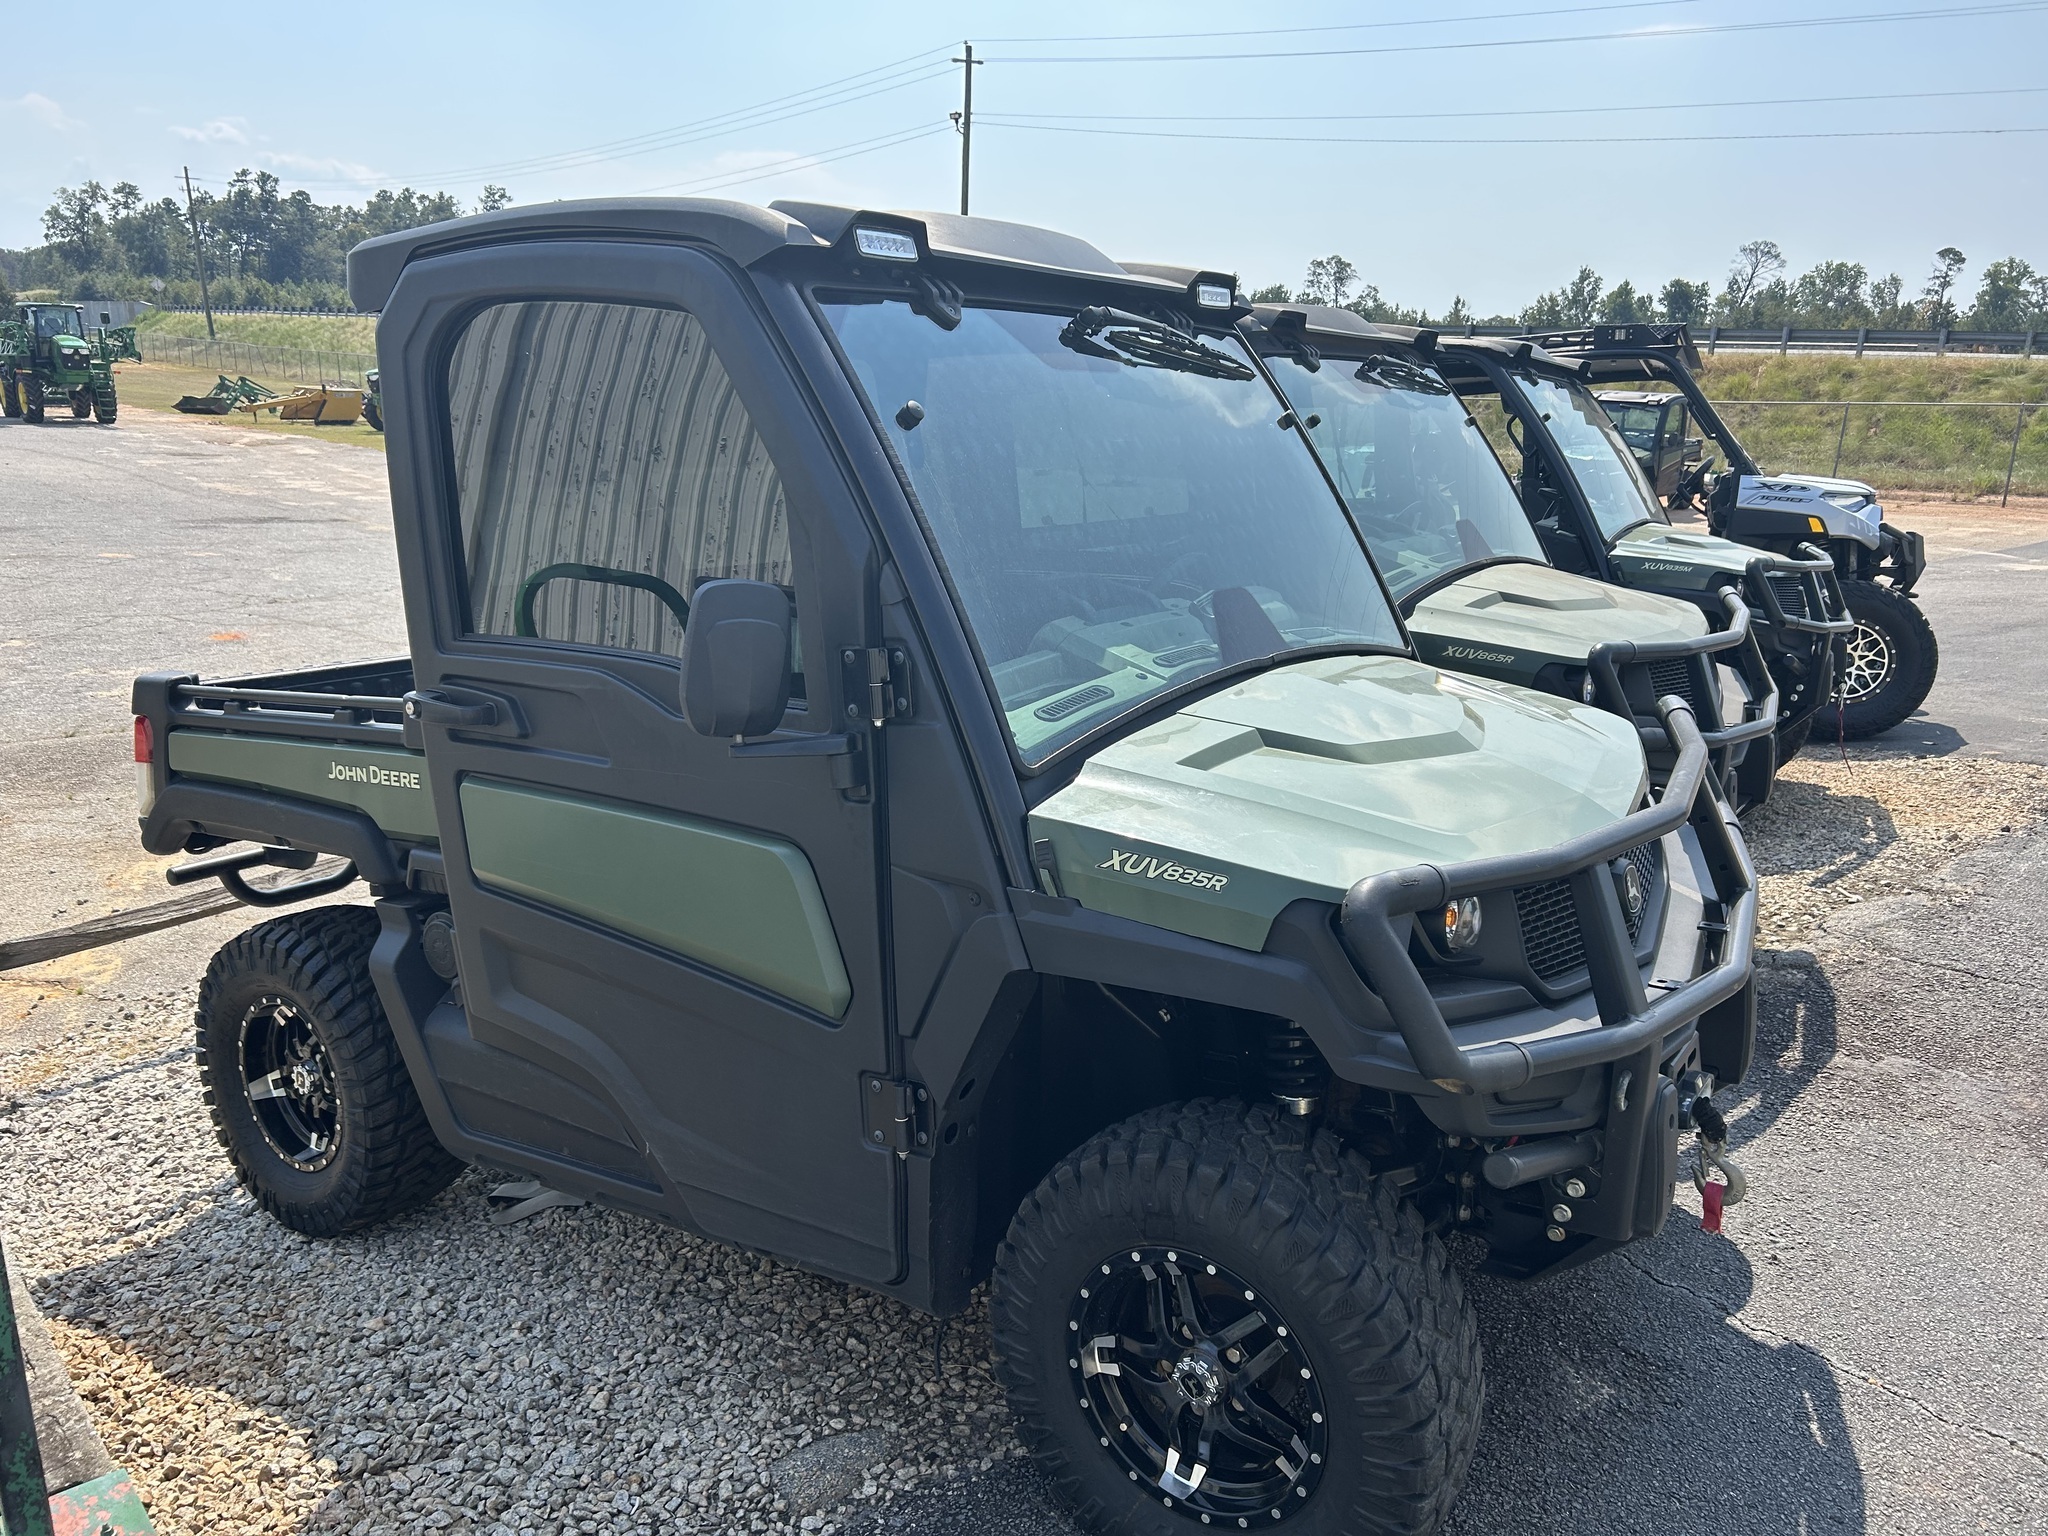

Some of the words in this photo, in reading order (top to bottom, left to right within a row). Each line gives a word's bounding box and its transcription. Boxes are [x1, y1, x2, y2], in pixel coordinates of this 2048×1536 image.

[1744, 482, 1811, 494] XP
[1748, 494, 1814, 505] 1000
[1641, 562, 1693, 573] XUV835M
[1442, 645, 1515, 664] XUV865R
[328, 761, 367, 783] JOHN
[369, 765, 420, 789] DEERE
[1099, 849, 1228, 892] XUV835R
